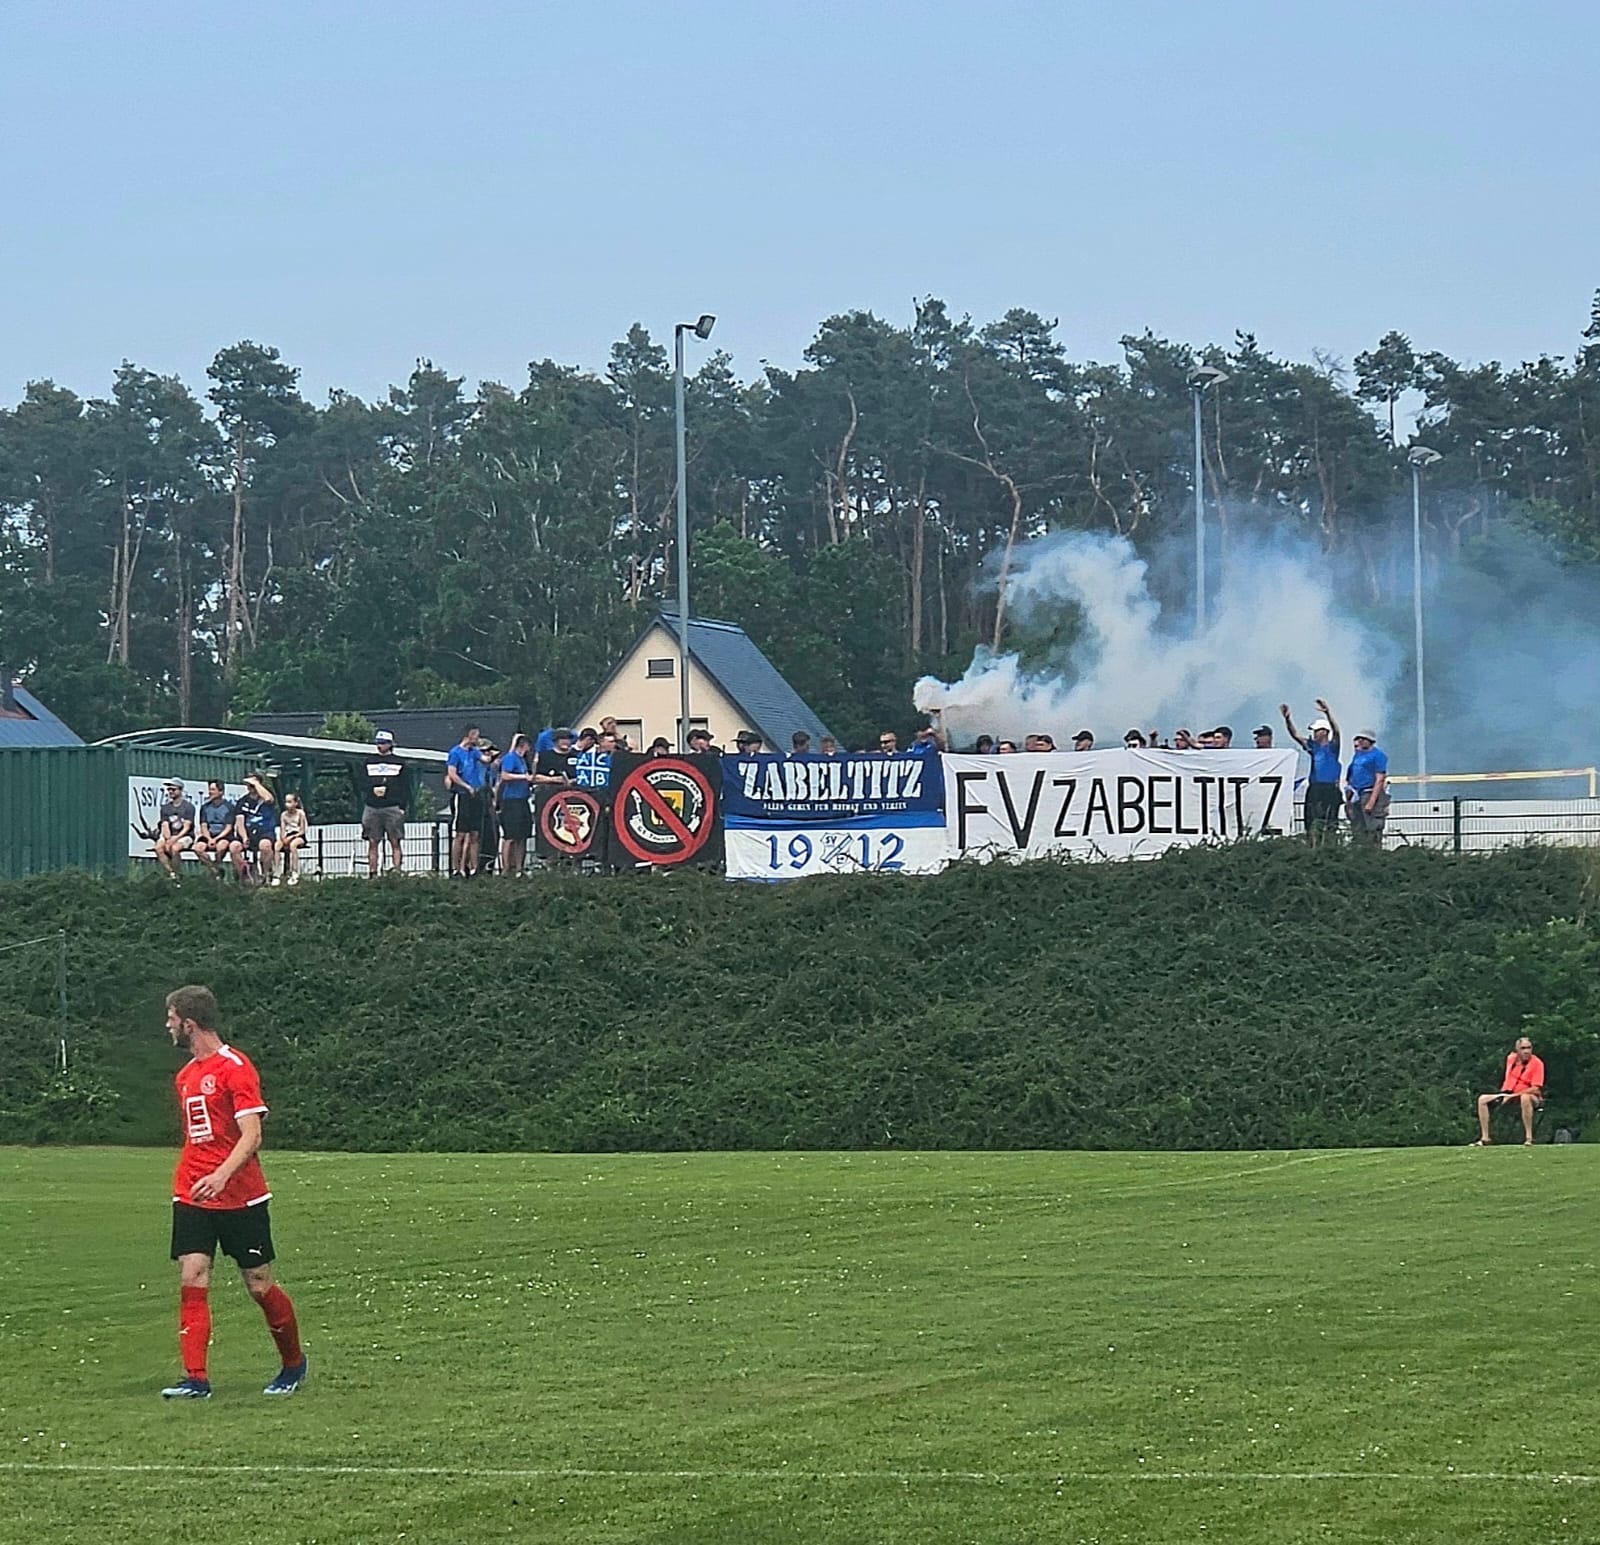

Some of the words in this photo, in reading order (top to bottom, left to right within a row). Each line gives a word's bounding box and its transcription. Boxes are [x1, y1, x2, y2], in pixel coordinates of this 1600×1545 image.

[738, 759, 923, 800] ZABELTITZ
[955, 770, 1046, 849] FV
[1052, 776, 1284, 838] ZABELTITZ
